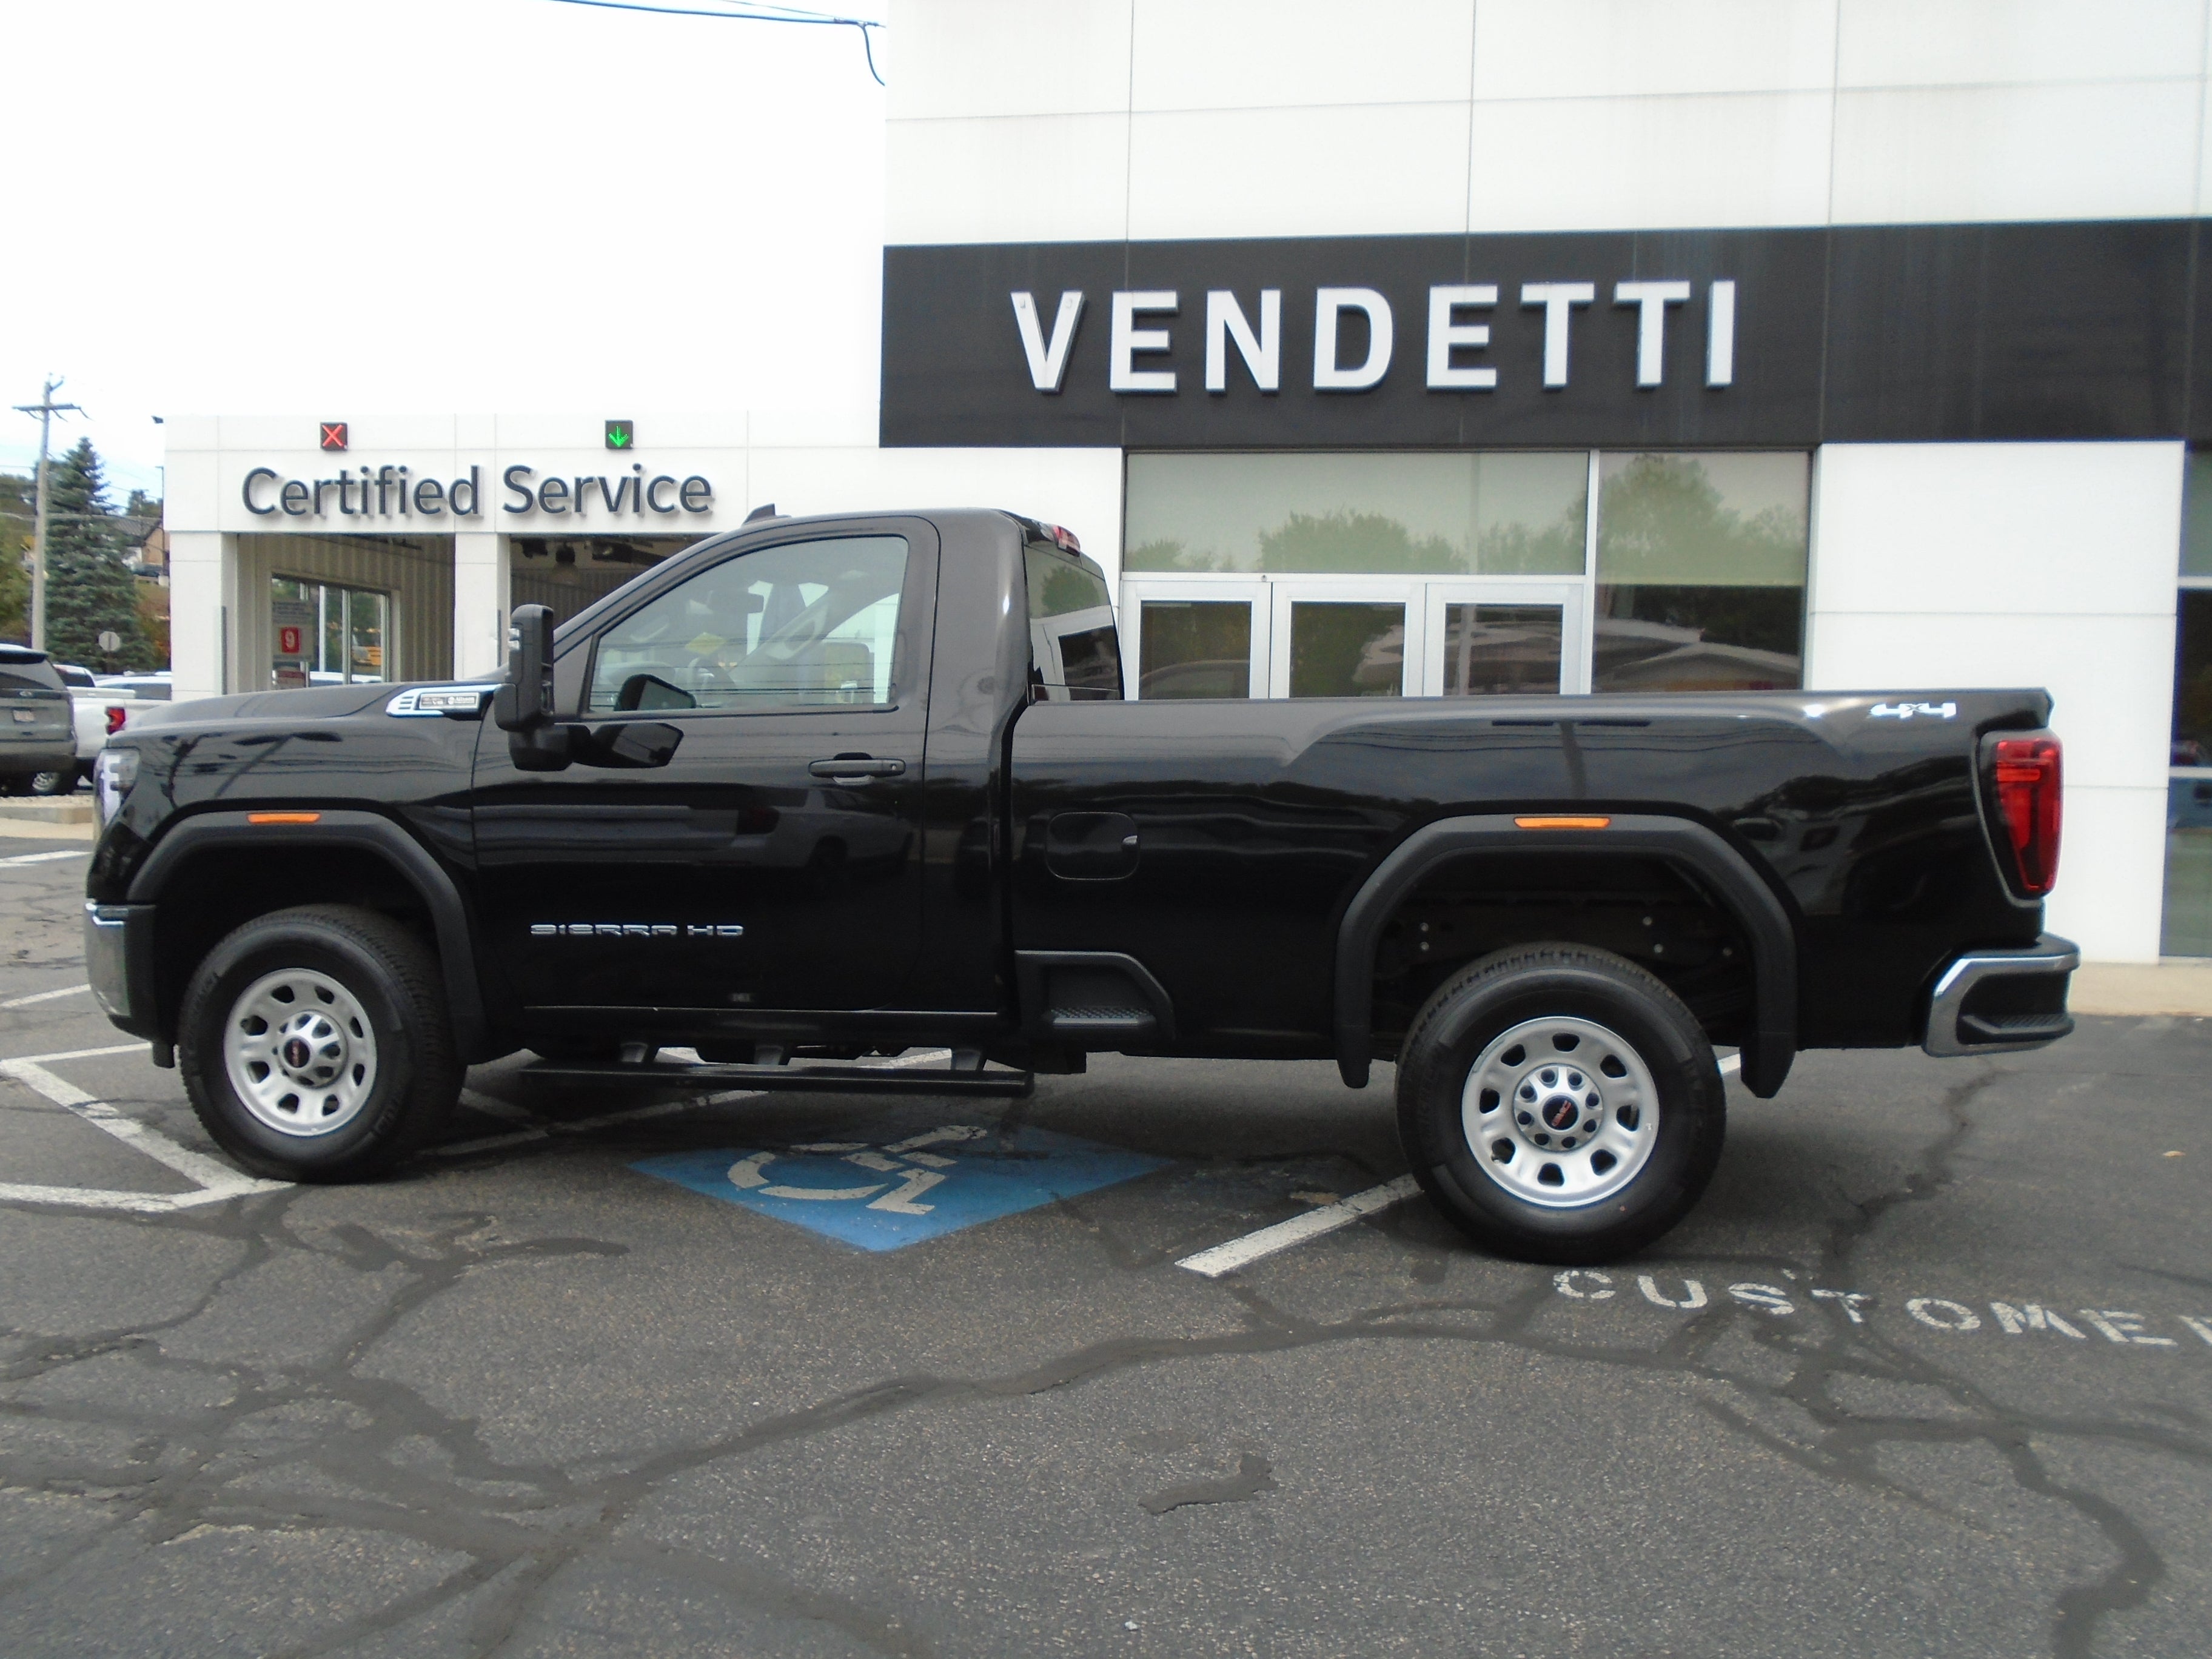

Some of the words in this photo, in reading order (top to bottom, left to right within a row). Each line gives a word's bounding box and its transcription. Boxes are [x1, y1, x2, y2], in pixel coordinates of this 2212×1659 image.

[1010, 280, 1737, 393] VENDETTI
[241, 464, 483, 517] Certified
[501, 463, 714, 515] Service
[531, 923, 678, 936] SIERRA
[687, 925, 744, 936] HD
